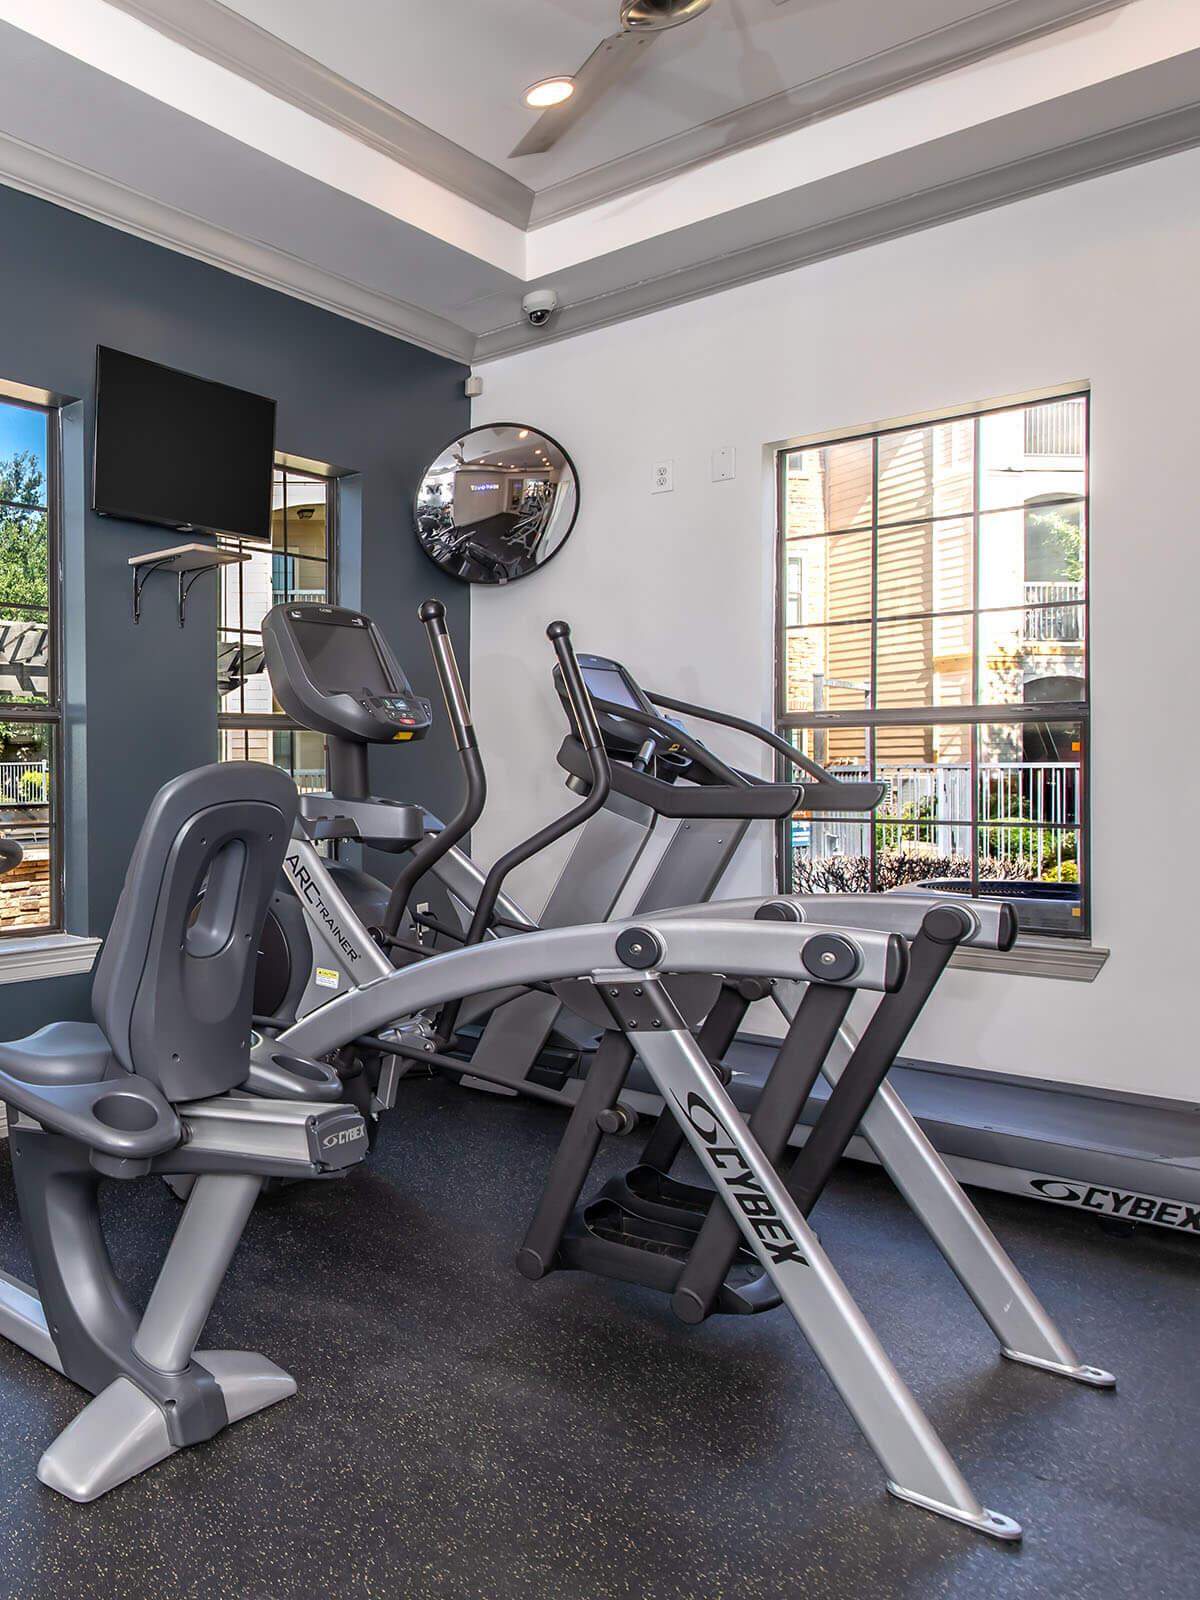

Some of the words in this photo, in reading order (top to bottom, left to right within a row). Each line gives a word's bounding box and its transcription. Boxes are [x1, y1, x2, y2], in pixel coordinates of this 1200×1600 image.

[338, 1124, 365, 1145] CYBEX
[705, 1146, 810, 1267] CYBEX
[1081, 1187, 1200, 1231] CYBEX
